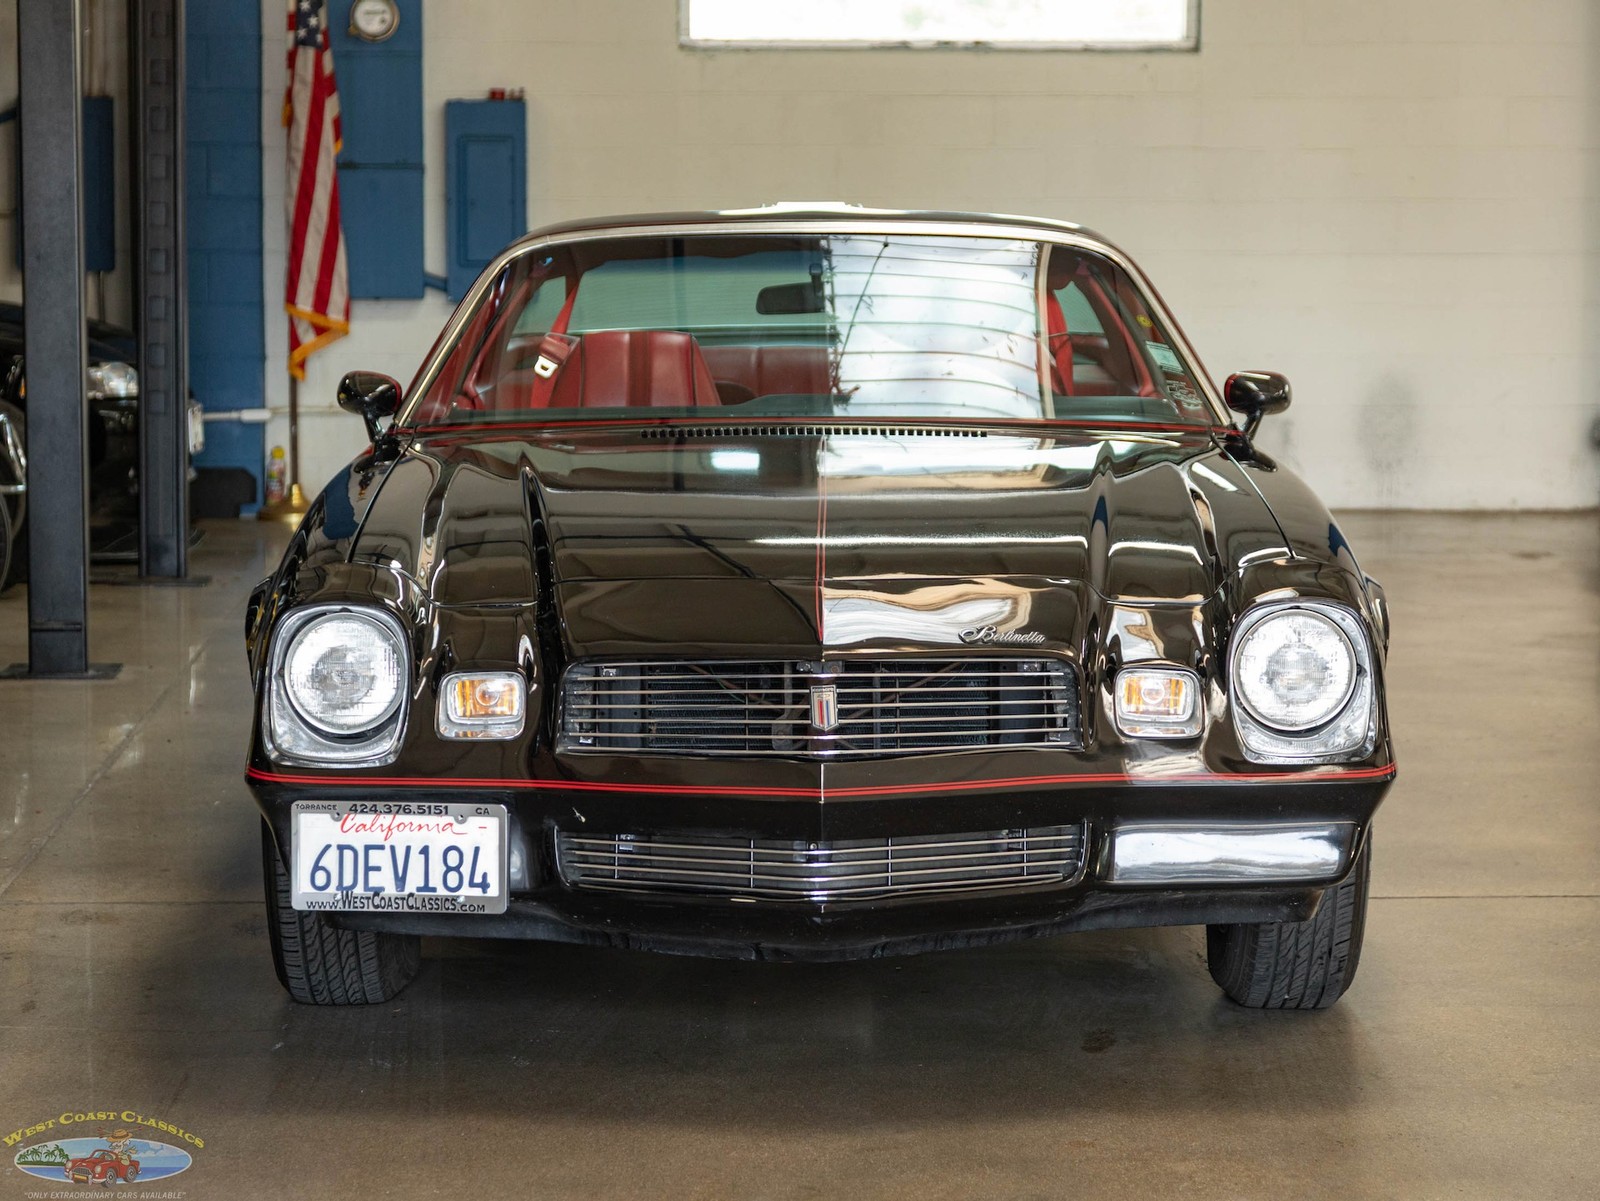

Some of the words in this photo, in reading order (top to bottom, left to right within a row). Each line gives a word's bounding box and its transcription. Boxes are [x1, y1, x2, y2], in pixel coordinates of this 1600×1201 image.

[958, 625, 1046, 645] Berlinetta
[295, 803, 337, 811] TORRANCE
[348, 803, 449, 816] 424.376.5151
[475, 807, 490, 815] CA
[340, 813, 468, 841] California
[310, 844, 491, 894] 6DEV184
